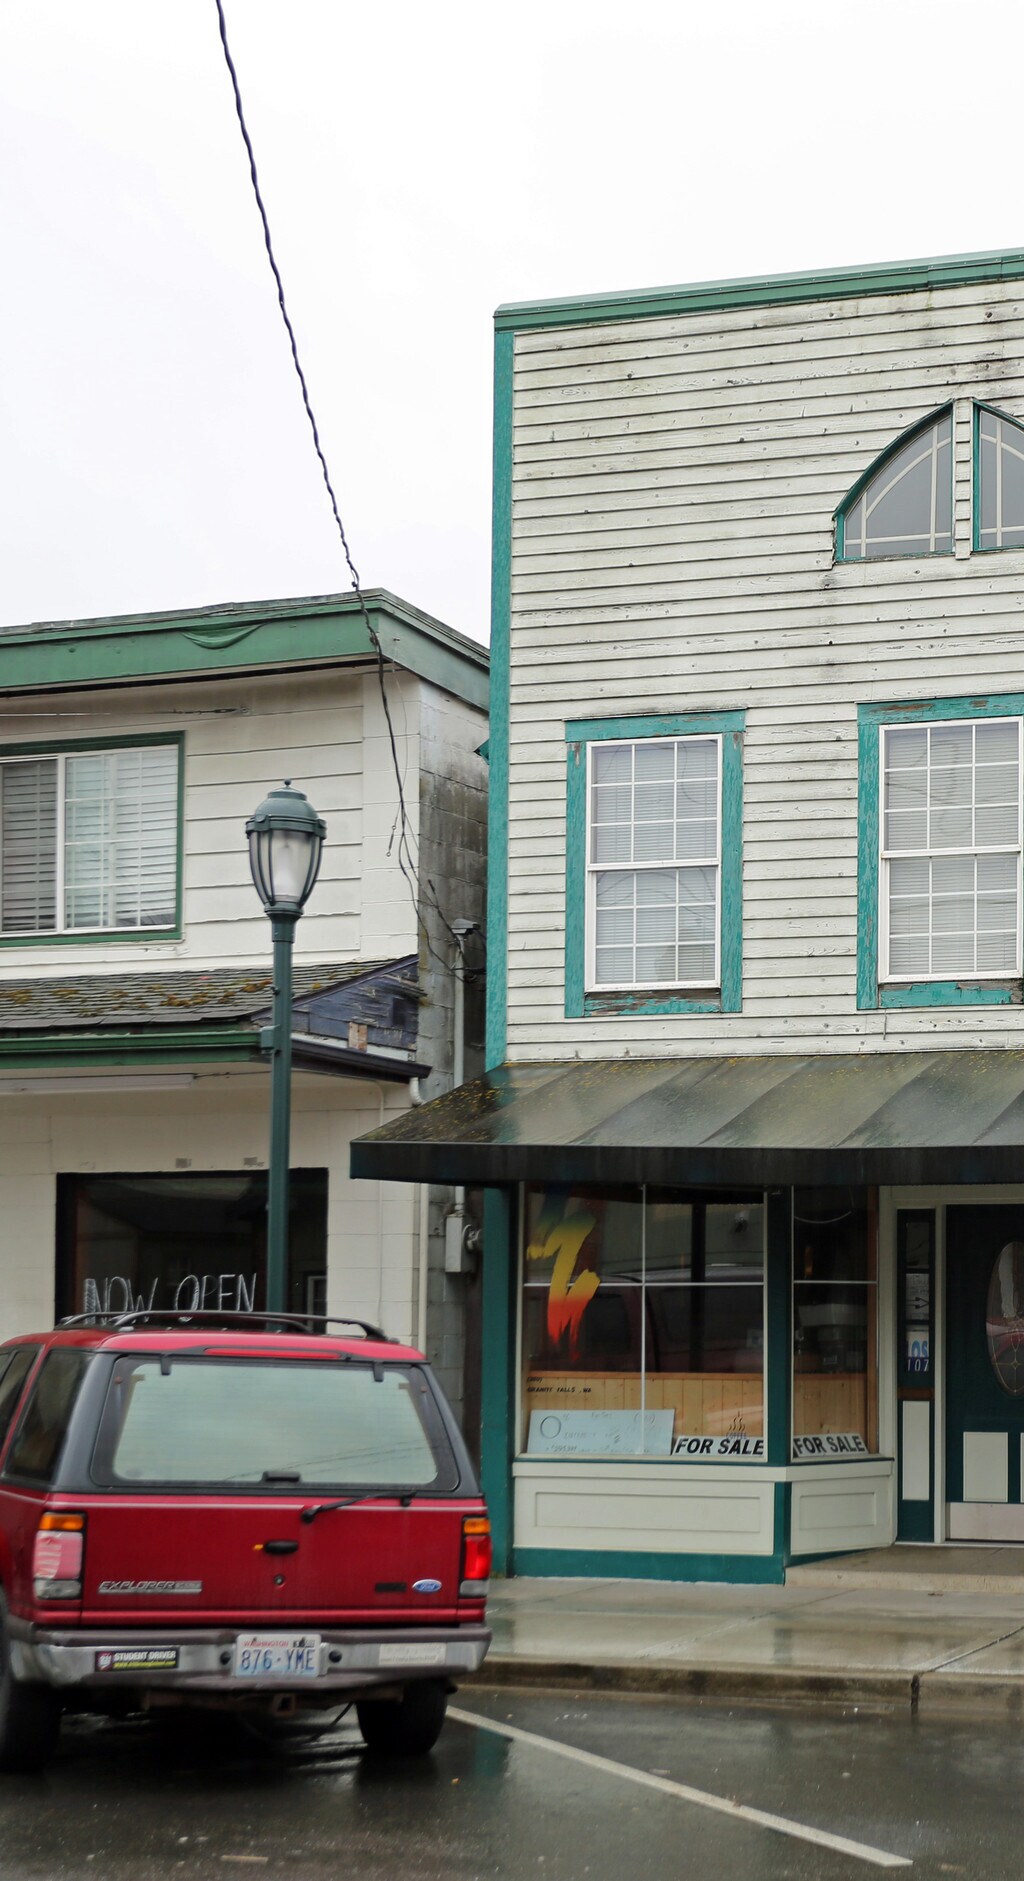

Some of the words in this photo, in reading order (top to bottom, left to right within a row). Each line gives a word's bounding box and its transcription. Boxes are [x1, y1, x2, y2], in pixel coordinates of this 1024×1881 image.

[174, 1272, 257, 1321] OPEN
[675, 1438, 714, 1454] FOR
[717, 1437, 764, 1456] SALE
[795, 1436, 825, 1454] FOR
[828, 1434, 865, 1453] SALE
[98, 1580, 176, 1591] EXPLORER
[113, 1651, 148, 1661] STUDENT
[148, 1650, 177, 1660] DRIVER
